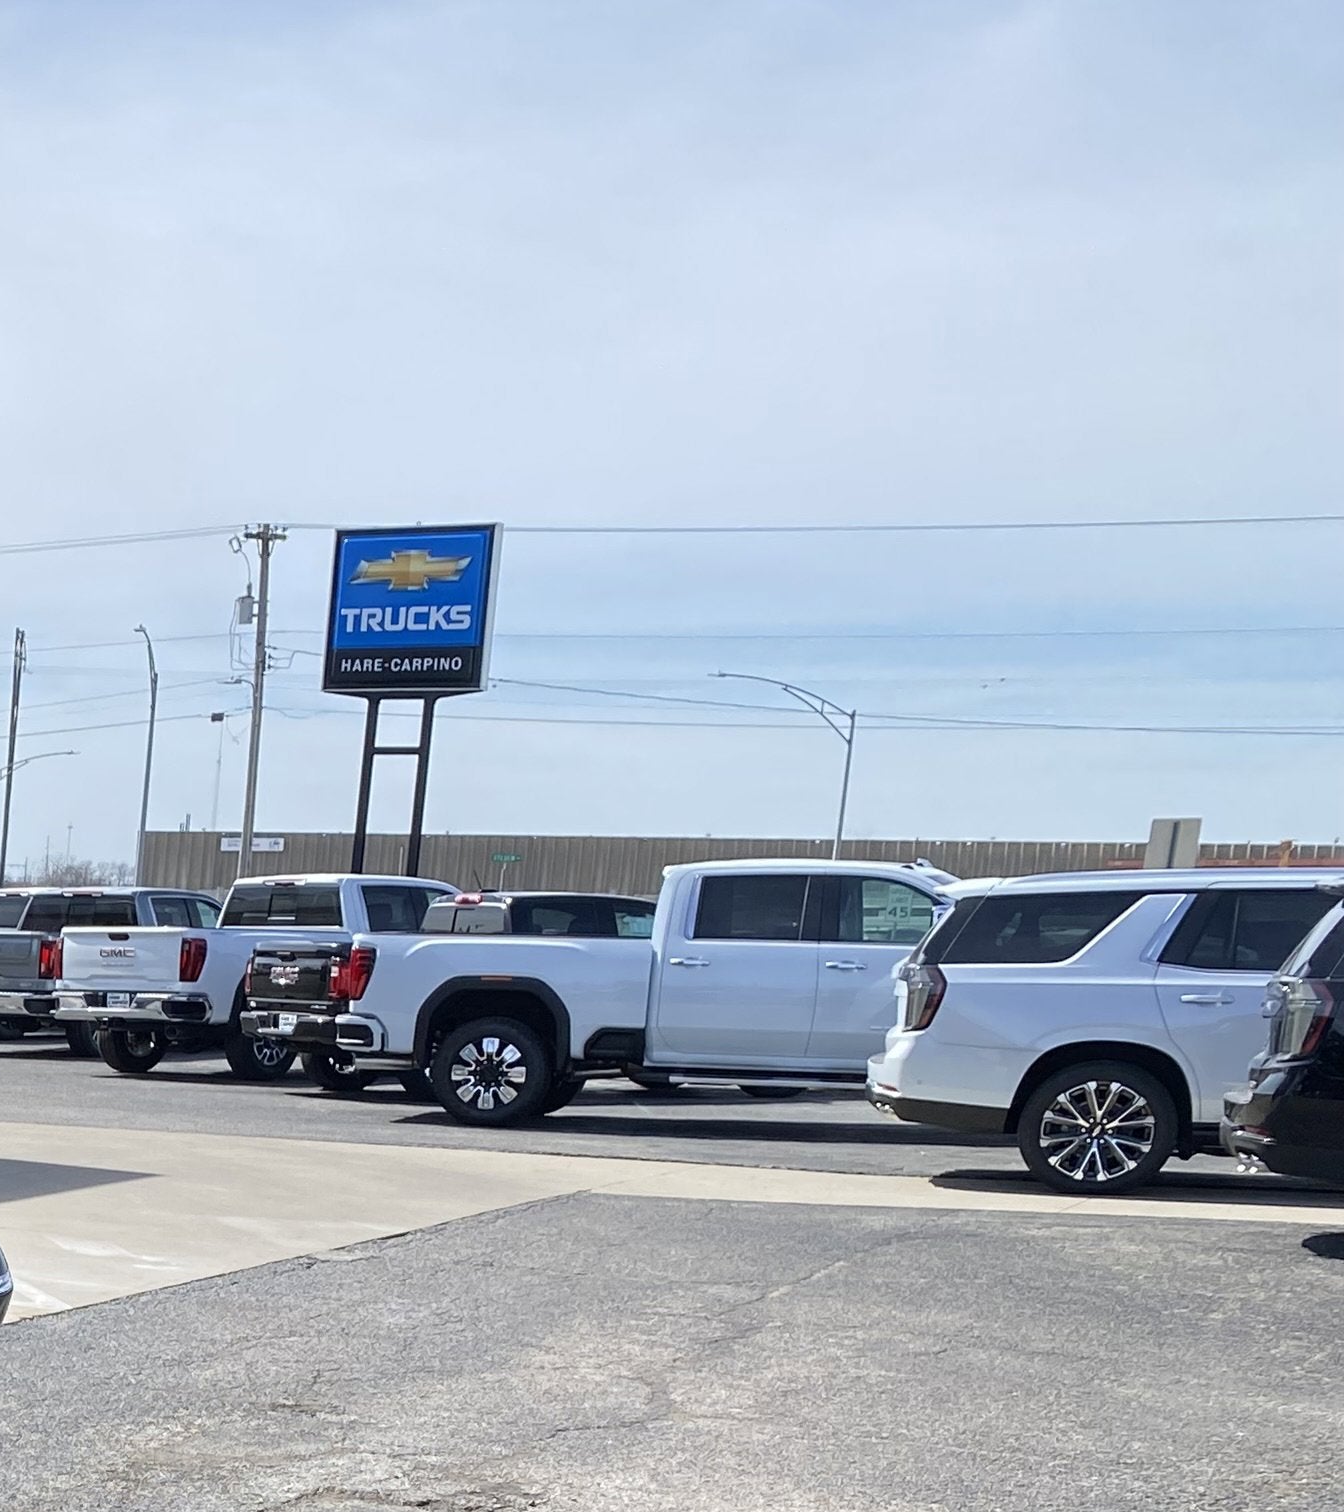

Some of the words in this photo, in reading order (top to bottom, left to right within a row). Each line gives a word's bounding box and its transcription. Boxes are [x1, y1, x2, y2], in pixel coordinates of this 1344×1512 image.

[340, 605, 472, 633] TRUCKS
[340, 656, 463, 672] HARE-CARPINO
[888, 906, 909, 918] 45
[99, 946, 136, 958] GMC
